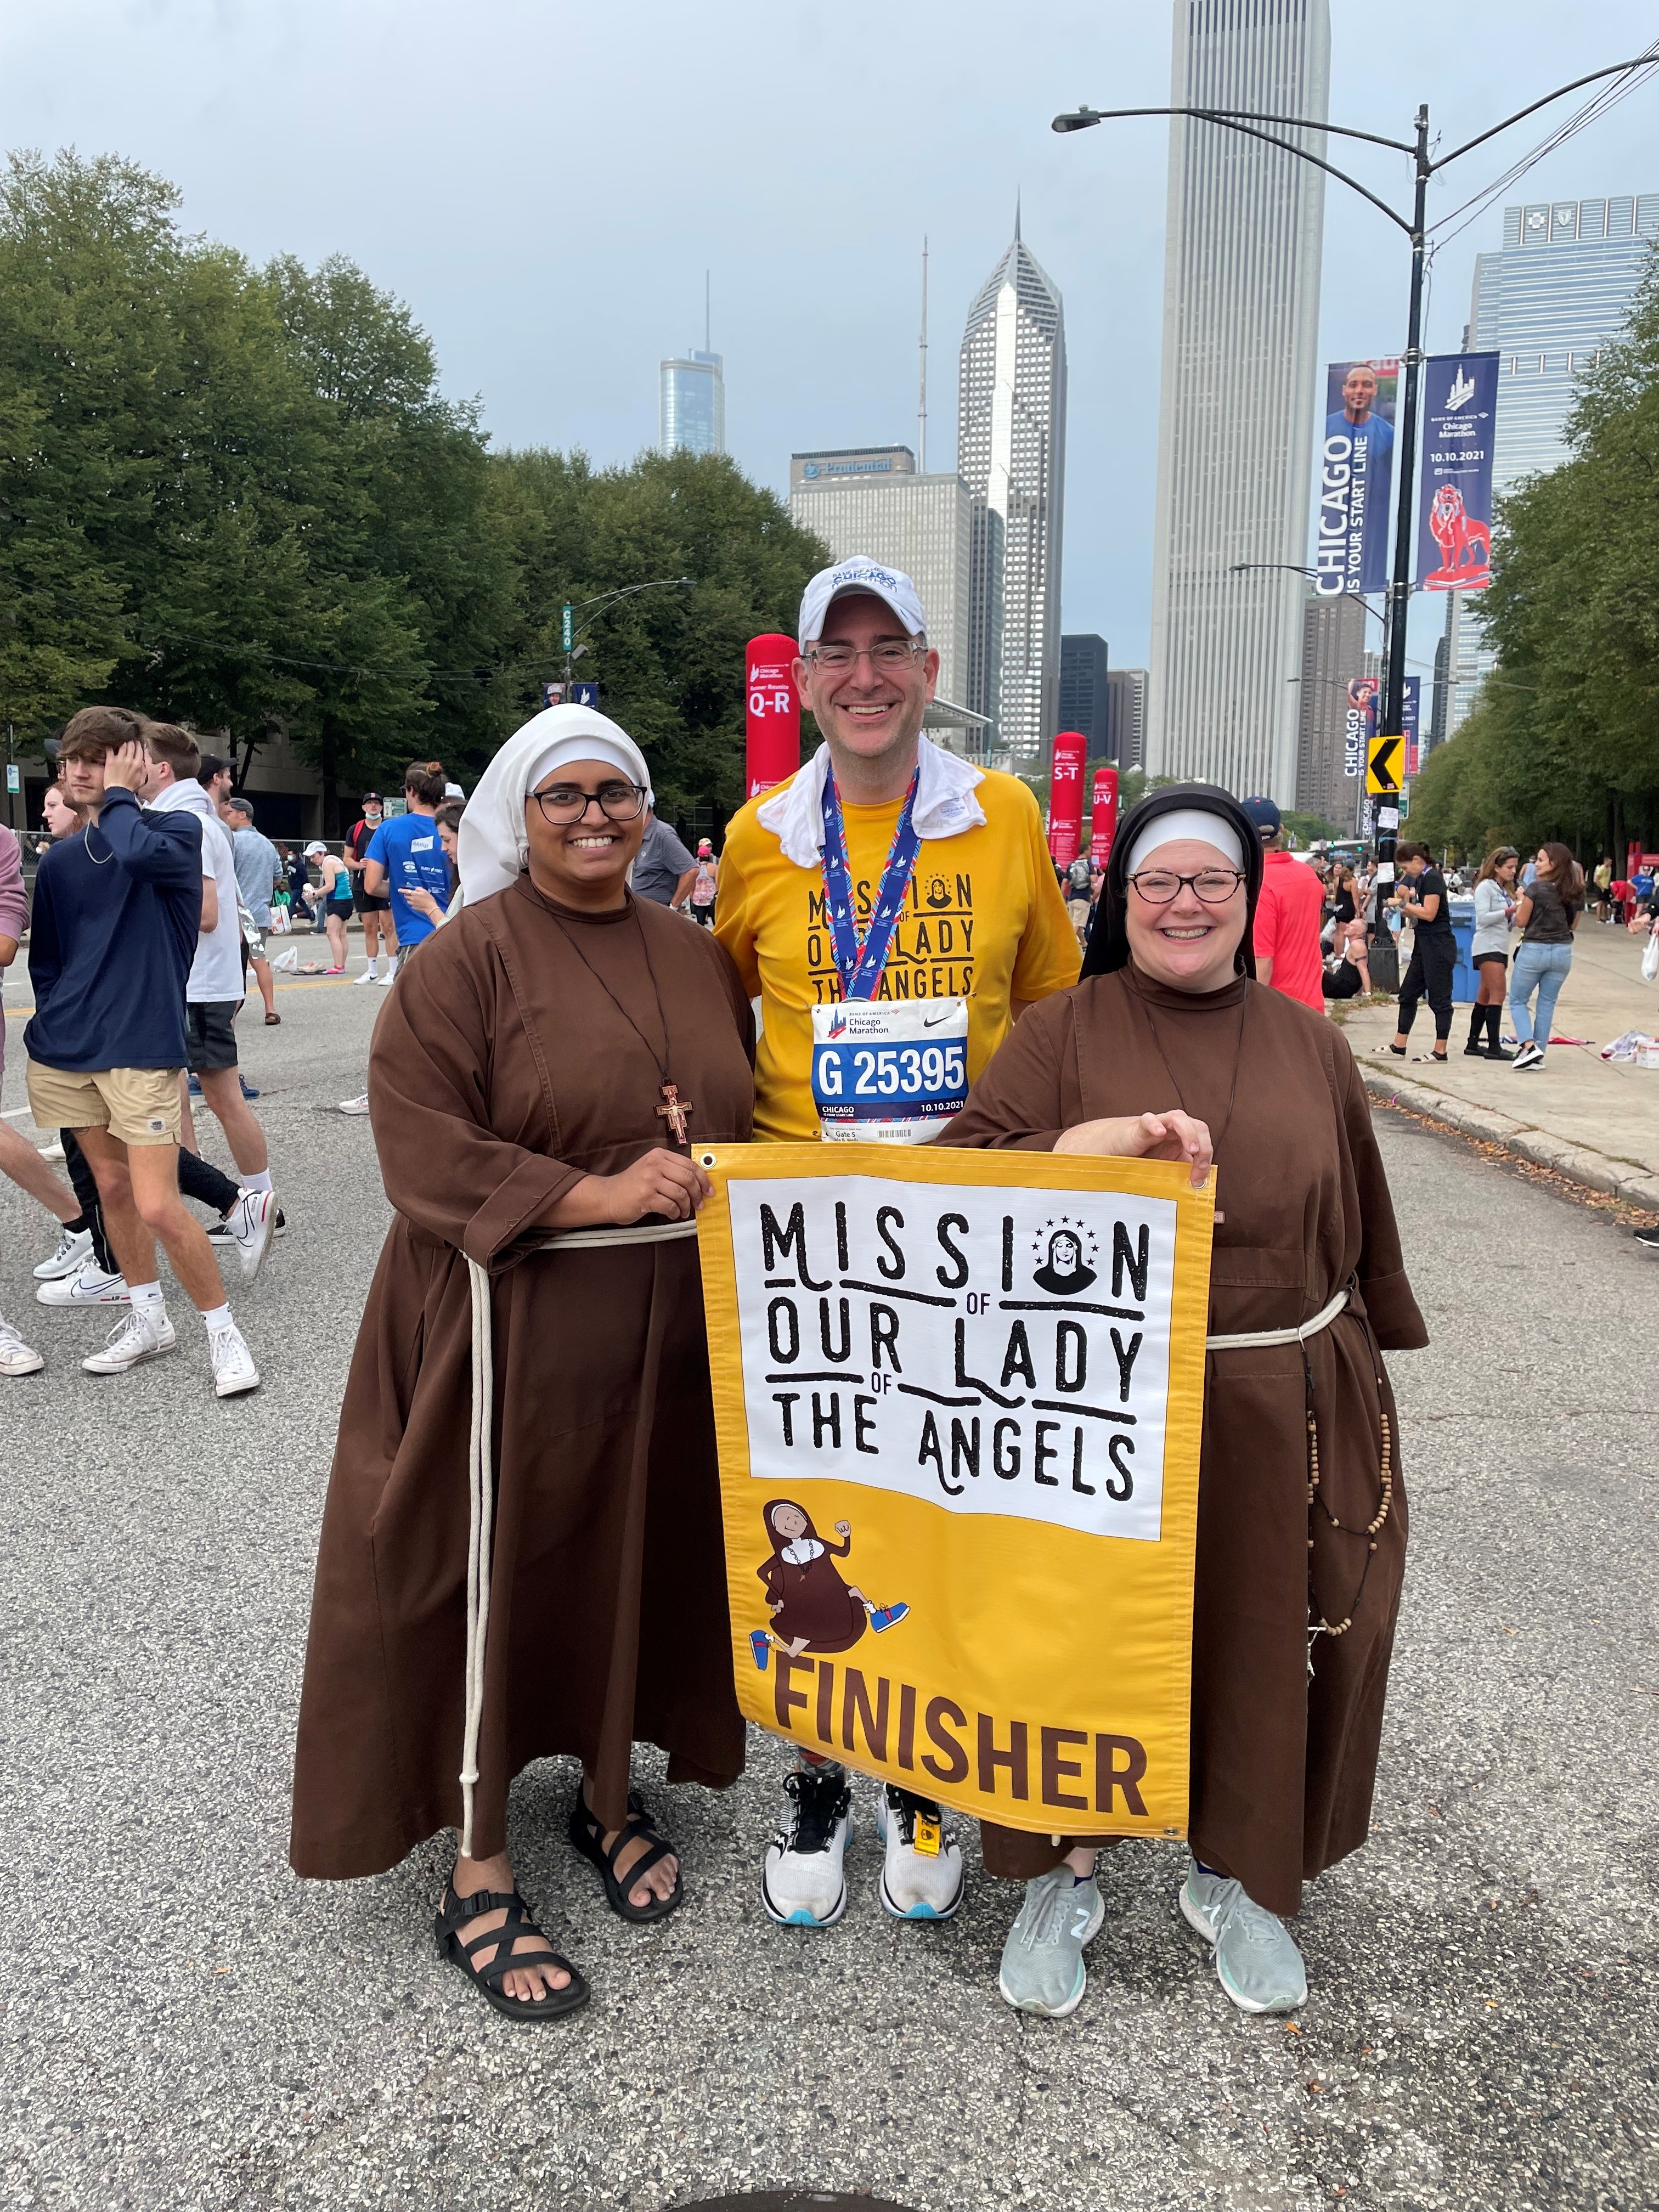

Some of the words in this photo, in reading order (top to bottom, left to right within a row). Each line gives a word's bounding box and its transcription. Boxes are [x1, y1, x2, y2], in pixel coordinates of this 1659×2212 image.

[1443, 422, 1473, 431] Chicago
[825, 458, 891, 475] Prudential
[1354, 436, 1368, 473] LINE
[1430, 450, 1485, 462] 10.10.2021
[1316, 435, 1352, 596] CHICAGO
[1350, 478, 1365, 527] START
[1348, 532, 1363, 575] YOUR
[1347, 579, 1360, 594] IS
[749, 692, 790, 717] Q-R
[1345, 708, 1360, 777] CHICAGO
[1054, 766, 1079, 780] S-T
[1093, 794, 1111, 805] U-V
[900, 911, 910, 922] OF
[878, 967, 973, 1001] ANGELS
[849, 1018, 881, 1027] Chicago
[819, 1051, 843, 1096] G
[854, 1046, 964, 1094] 25395
[921, 1101, 964, 1112] 10.10.2021
[966, 1292, 991, 1316] OF
[768, 1296, 902, 1373] OUR
[955, 1317, 1143, 1409] LADY
[871, 1372, 893, 1395] OF
[772, 1392, 879, 1454] THE
[918, 1409, 1135, 1502] ANGELS
[774, 1649, 1149, 1817] FINISHER
